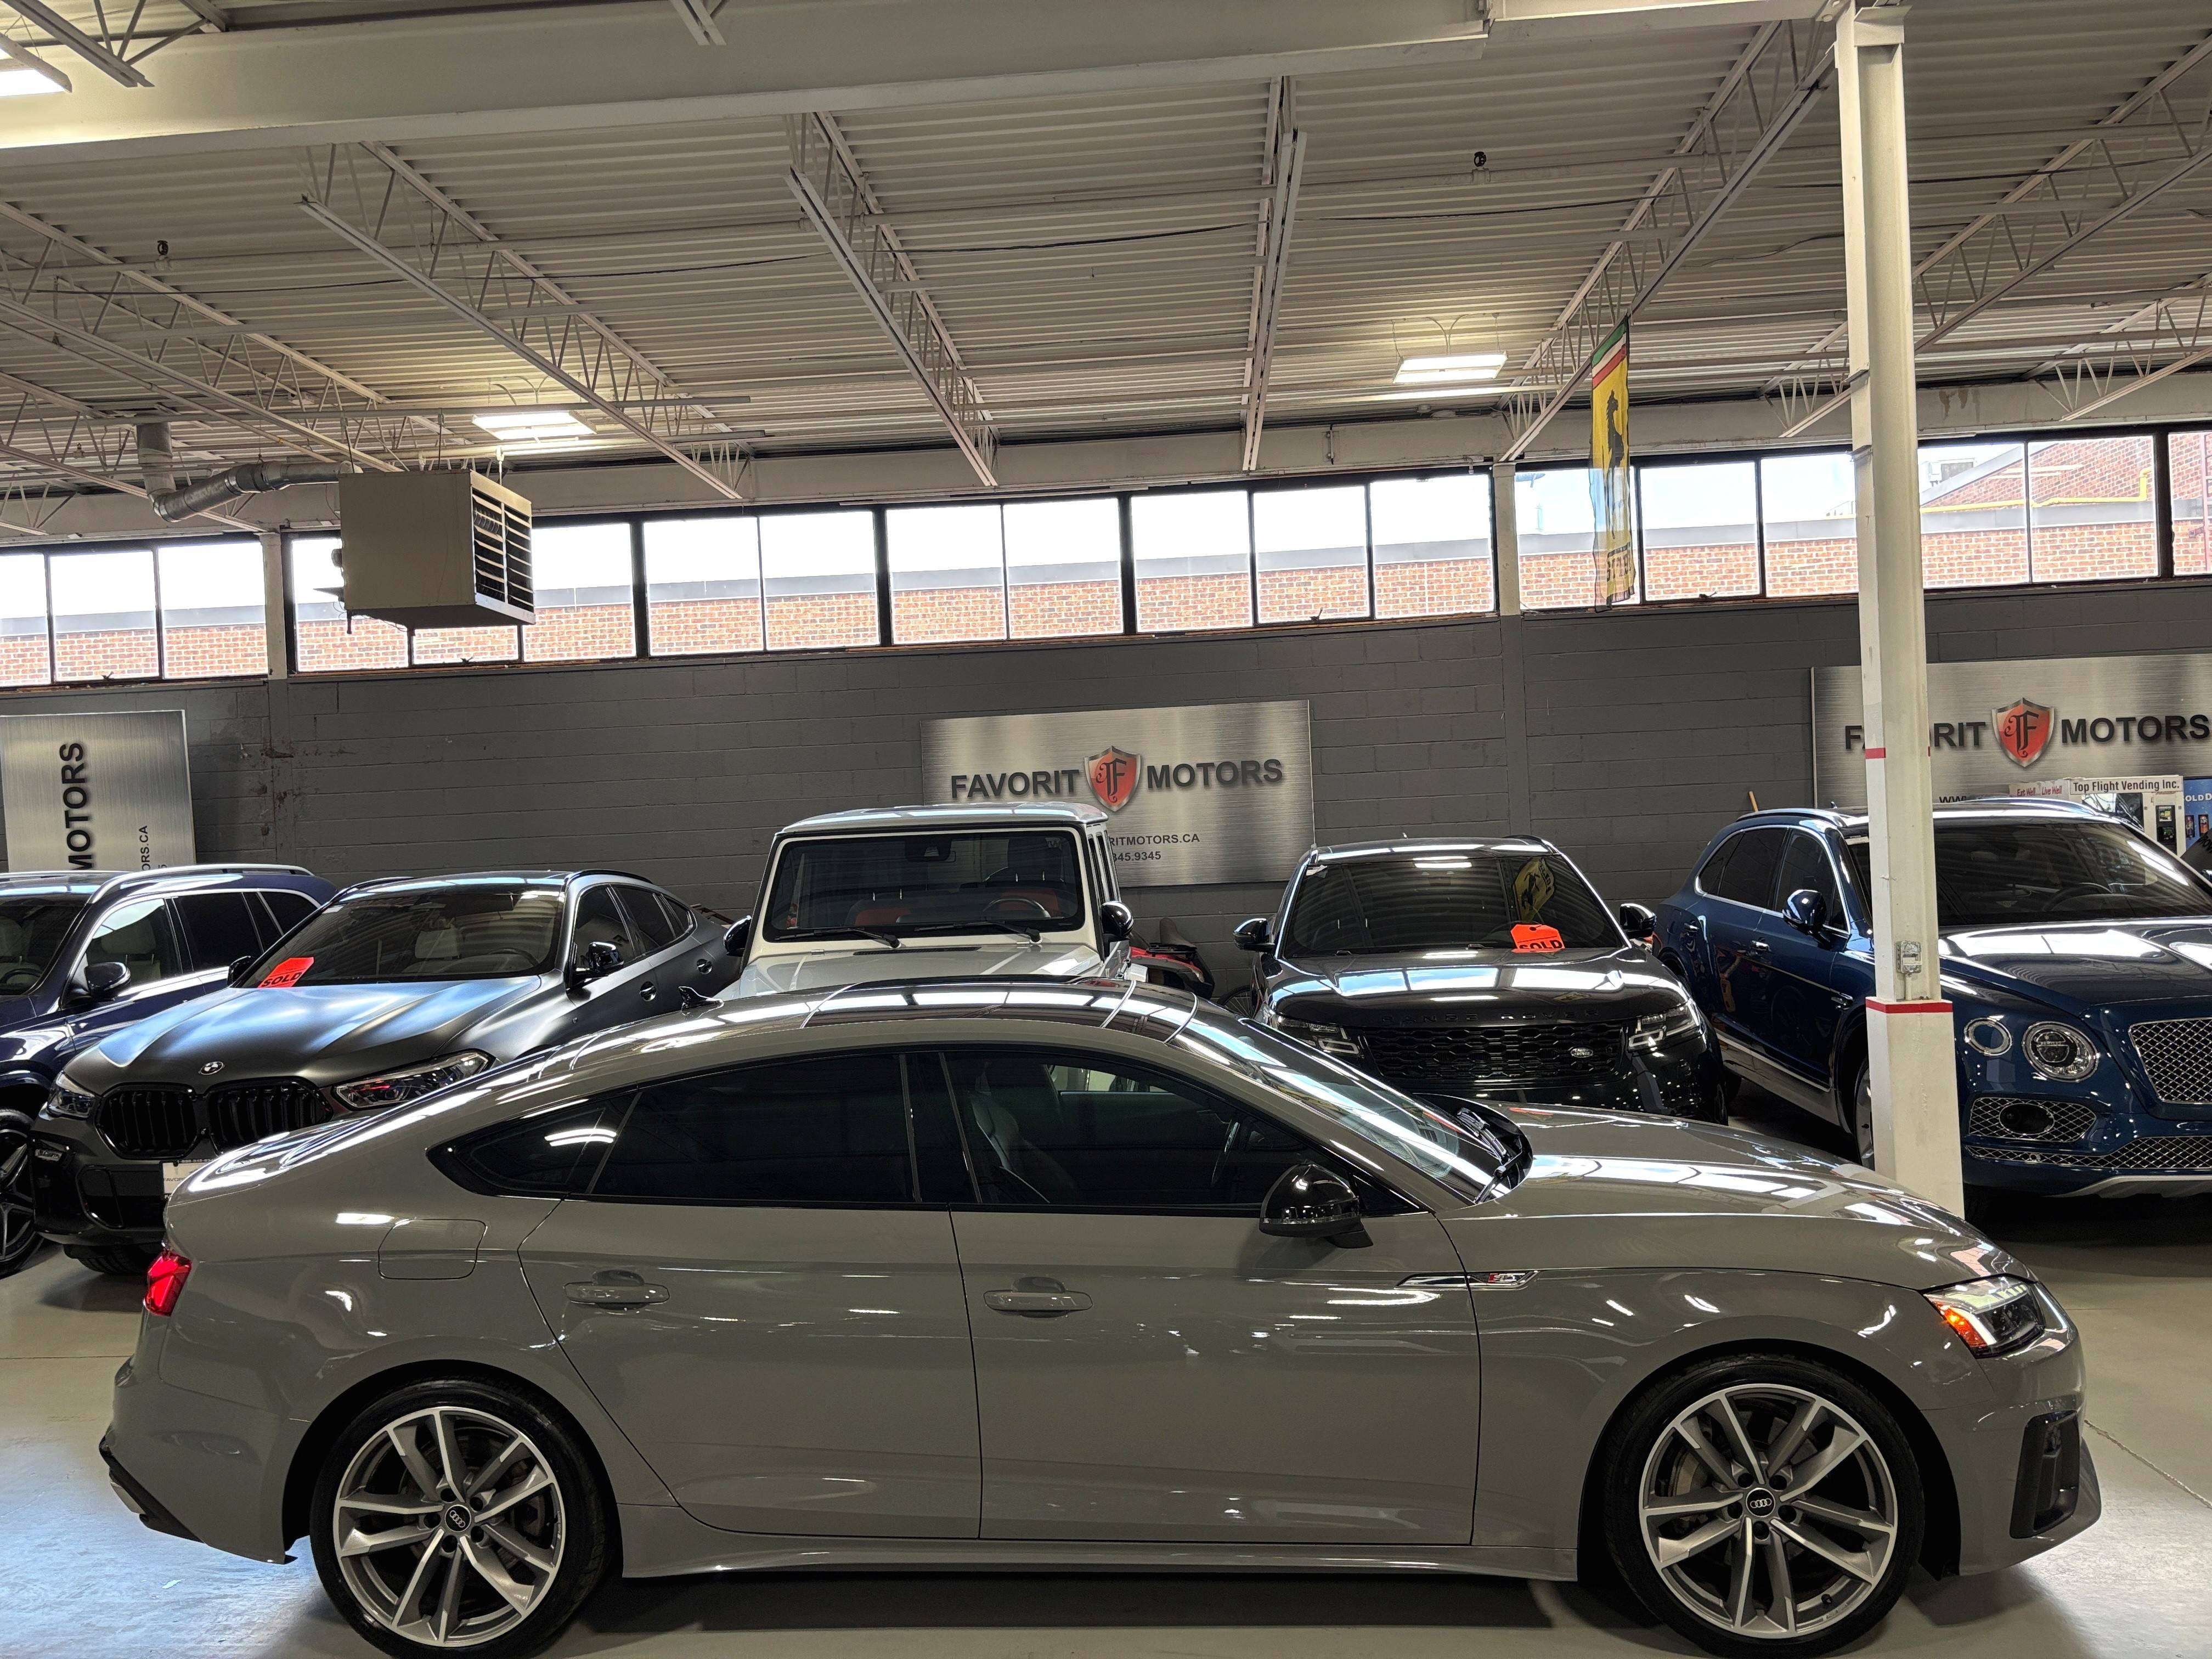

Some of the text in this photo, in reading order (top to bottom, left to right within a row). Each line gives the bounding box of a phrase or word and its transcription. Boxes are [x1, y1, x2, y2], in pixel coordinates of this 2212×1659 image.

[1845, 721, 1986, 750] FRIT
[2062, 714, 2210, 744] MOTORS
[951, 769, 1079, 799] FAVORIT
[1147, 759, 1283, 791] MOTORS
[2073, 779, 2180, 793] Top Flight Vending Inc.
[59, 743, 93, 871] MOTORS
[261, 972, 302, 987] SOLD
